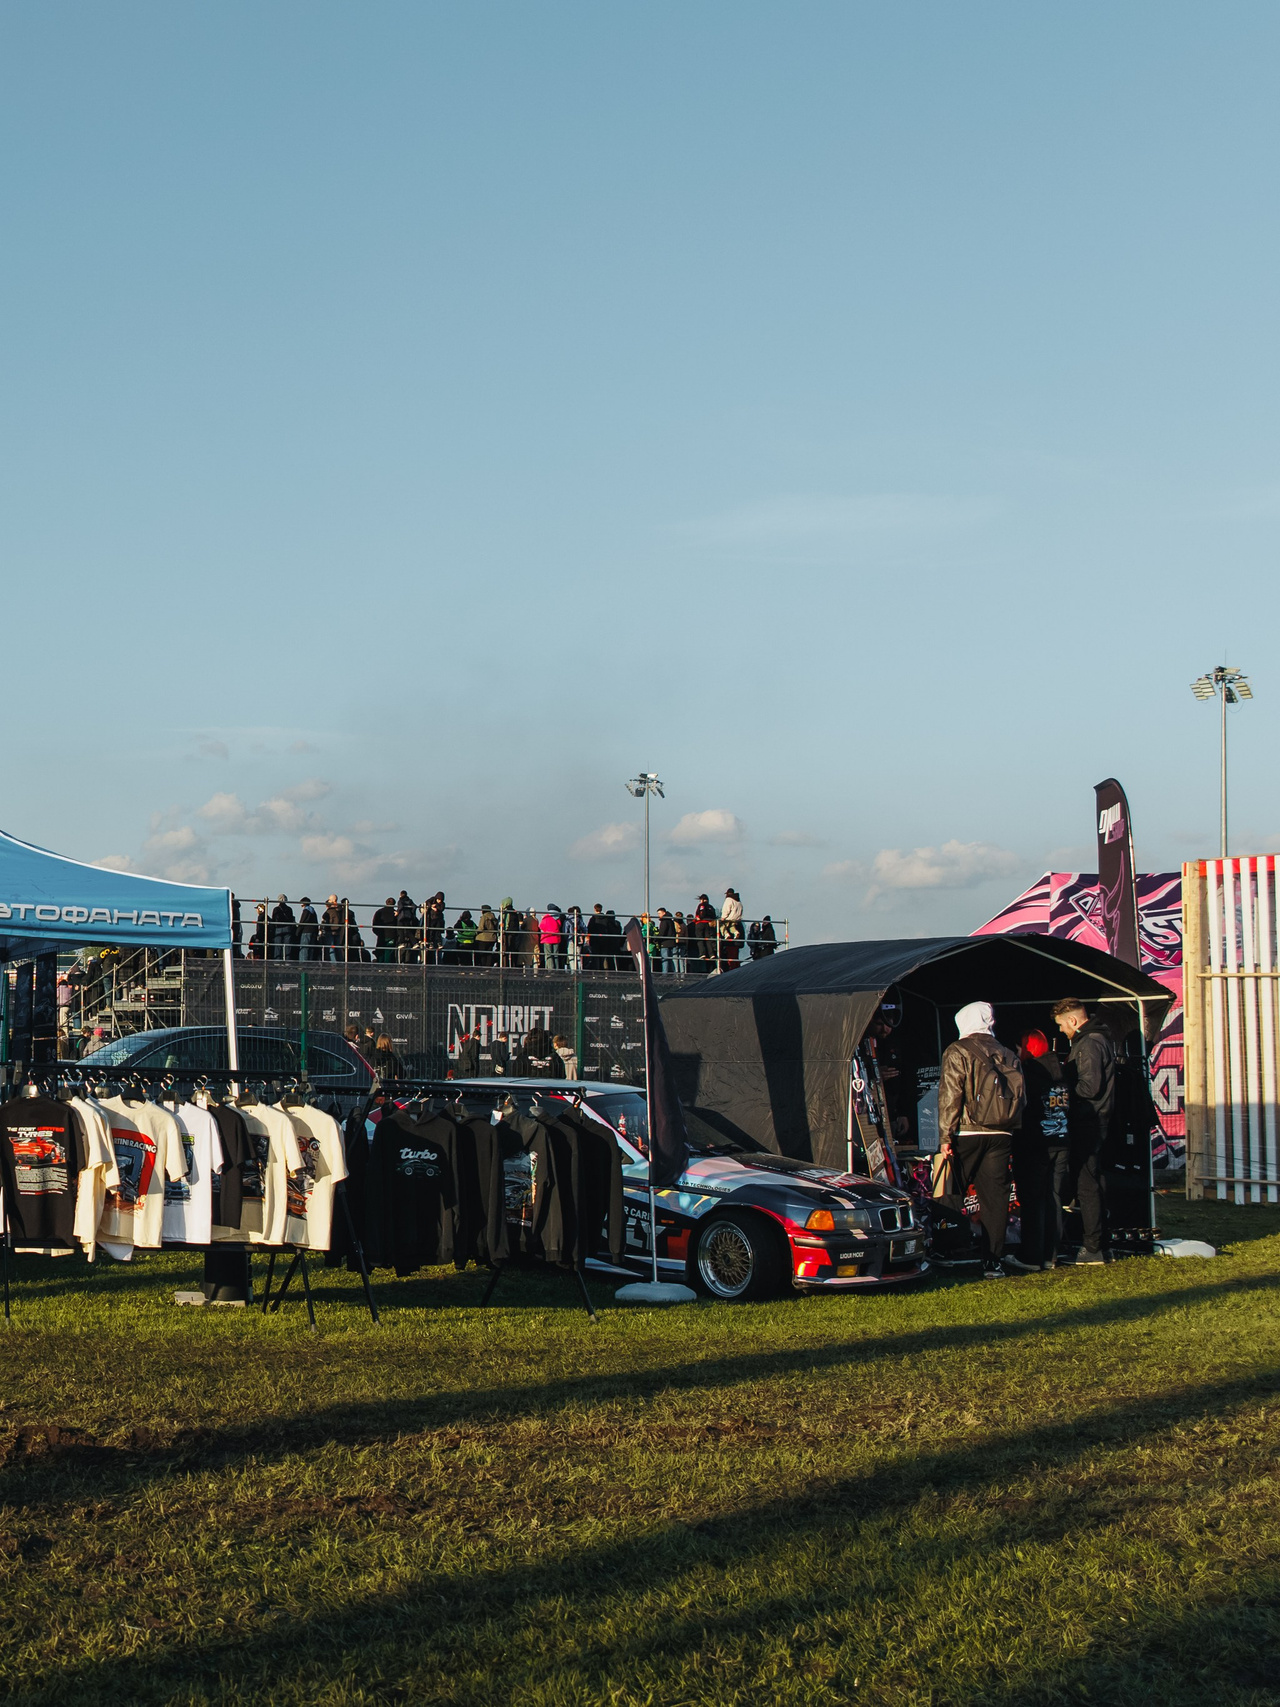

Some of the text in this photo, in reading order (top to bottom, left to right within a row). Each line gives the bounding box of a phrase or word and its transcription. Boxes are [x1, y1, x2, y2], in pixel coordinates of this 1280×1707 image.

[17, 1130, 54, 1138] TYRES
[129, 1140, 157, 1154] RACING
[399, 1147, 438, 1161] turbo
[691, 1182, 731, 1193] TECHNOLOGIES
